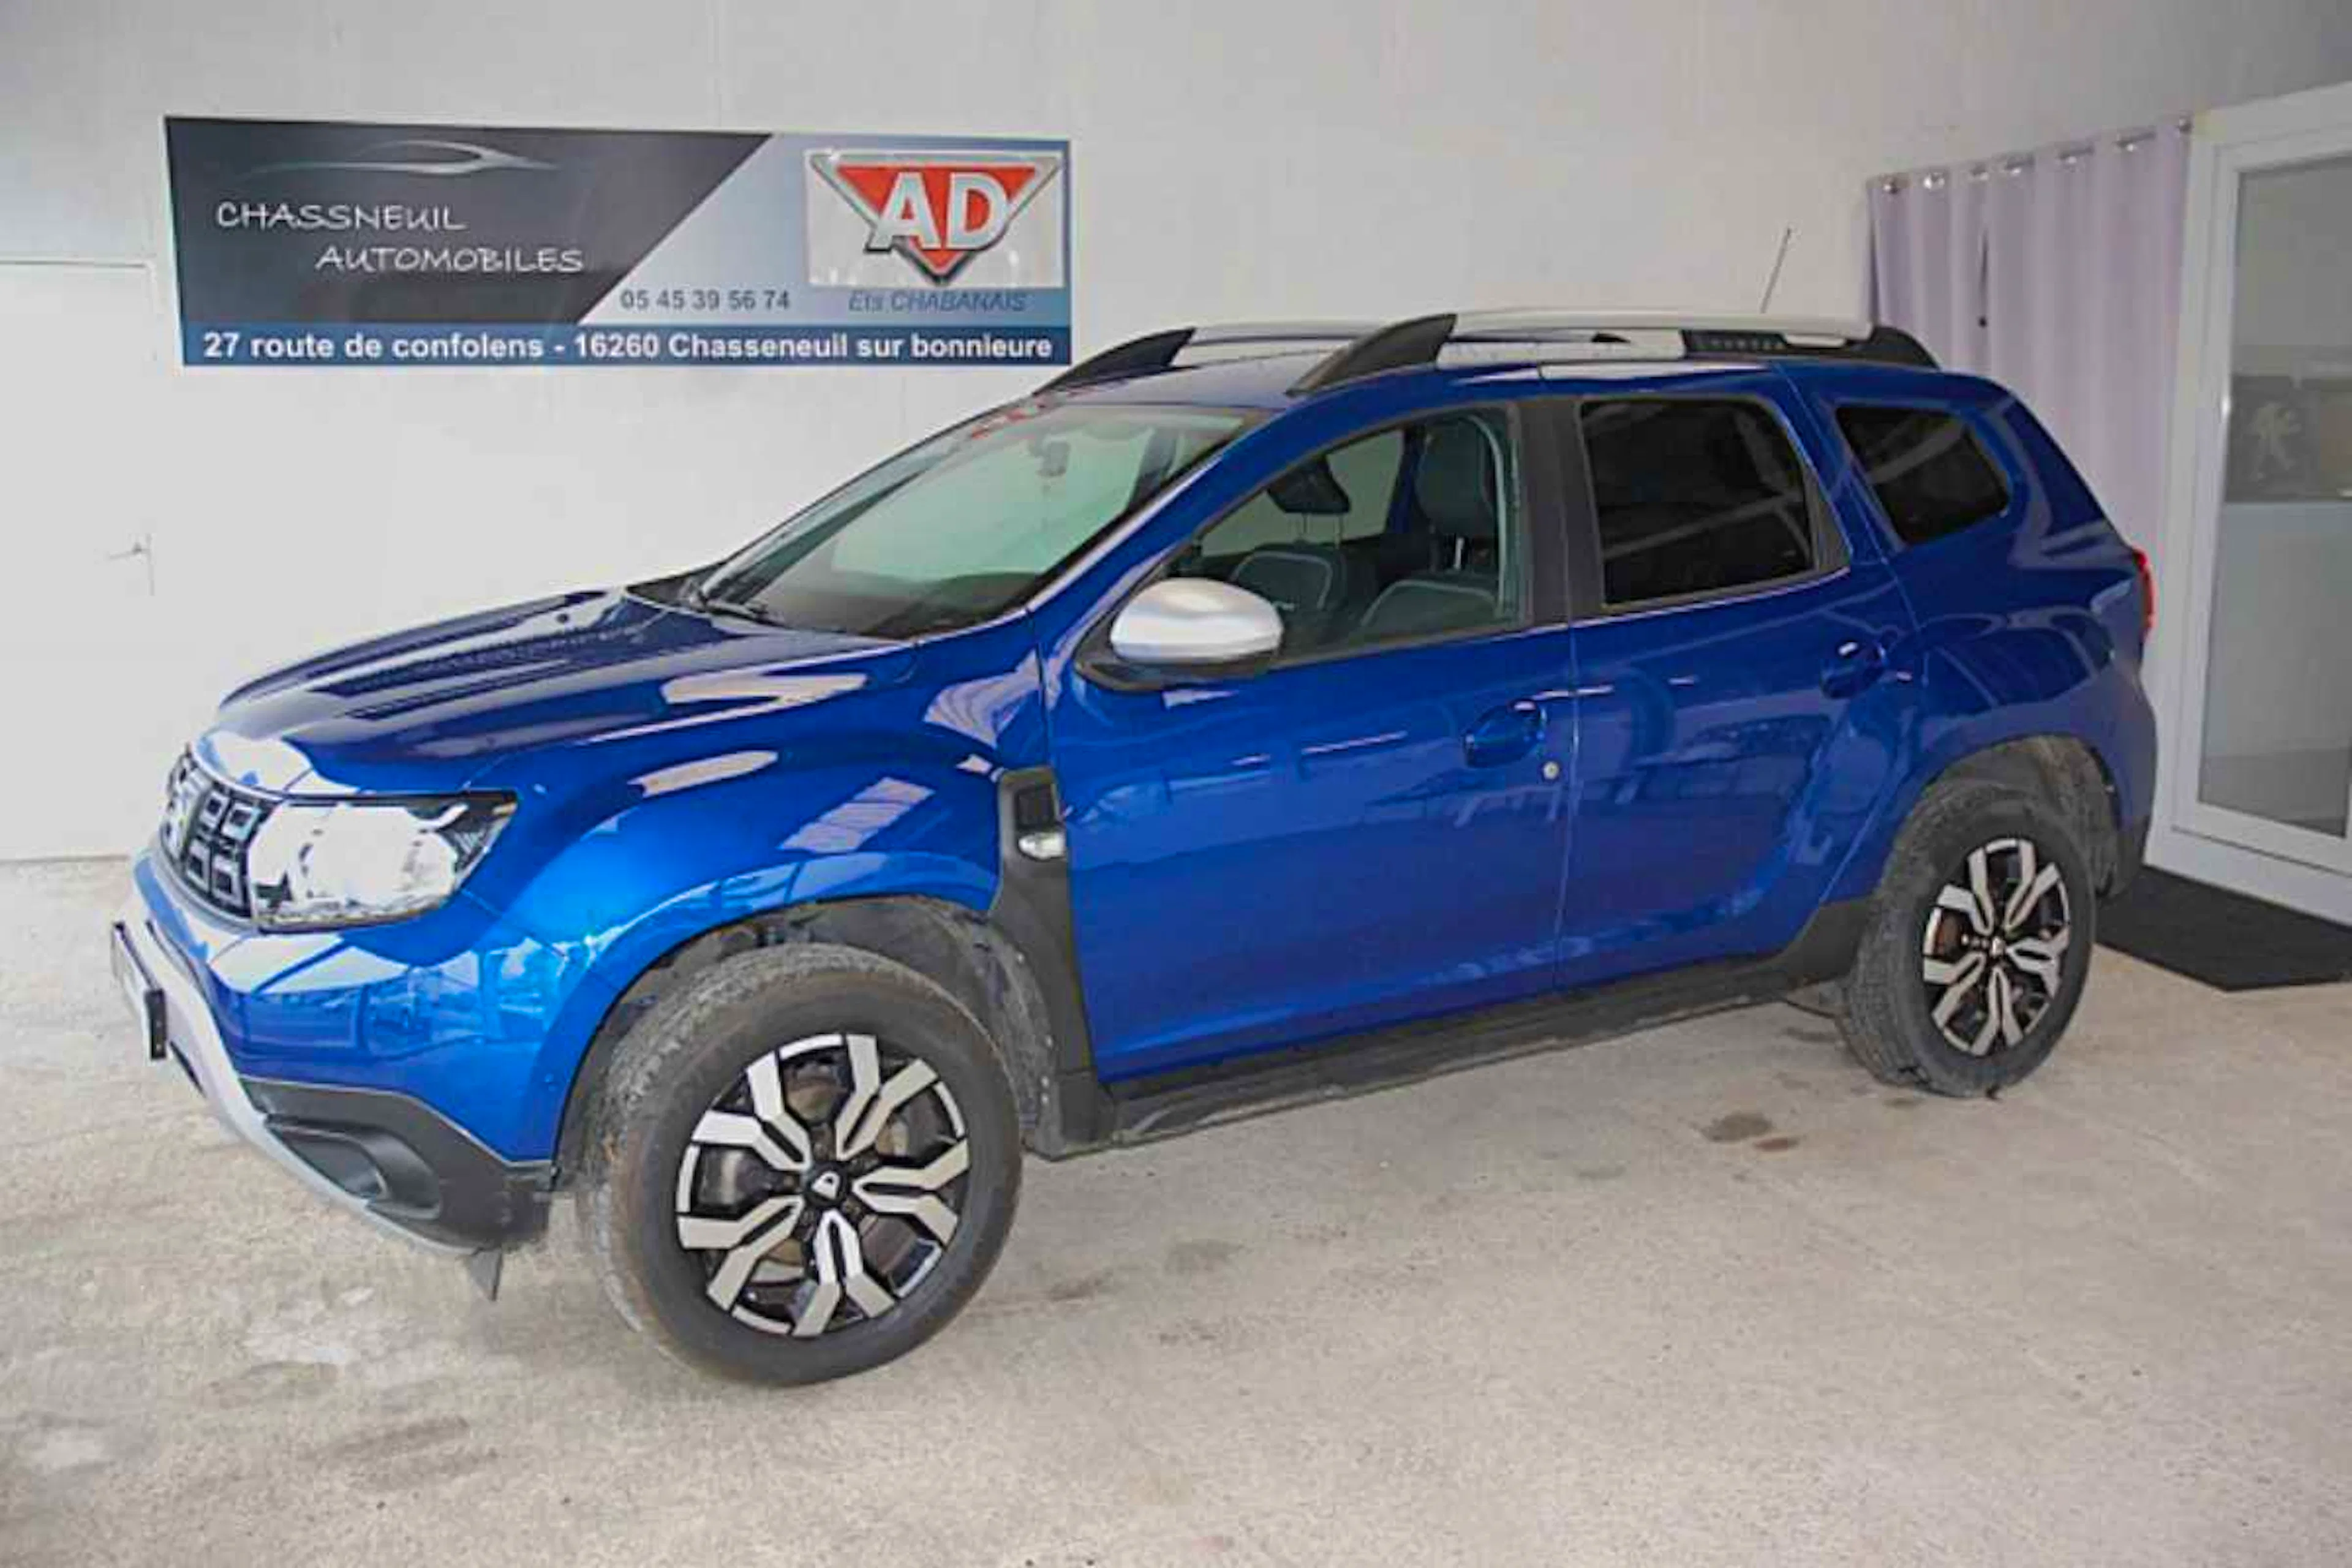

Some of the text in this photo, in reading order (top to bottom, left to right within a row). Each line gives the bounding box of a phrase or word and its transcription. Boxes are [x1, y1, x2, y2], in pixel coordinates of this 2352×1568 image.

[216, 202, 468, 231] CHASSNEUIL
[865, 171, 1012, 252] AD
[315, 245, 584, 273] AUTOMOBILES
[619, 289, 791, 310] 05 45 39 56 74
[848, 290, 1027, 312] Ets CHABANAIS
[203, 331, 239, 358] 27
[250, 333, 335, 358] route
[344, 331, 381, 358] de
[391, 331, 545, 358] confolens
[573, 333, 658, 358] 16260
[668, 333, 848, 358] Chasseneuil
[858, 337, 906, 358] sur
[910, 333, 1053, 358] bonnieure
